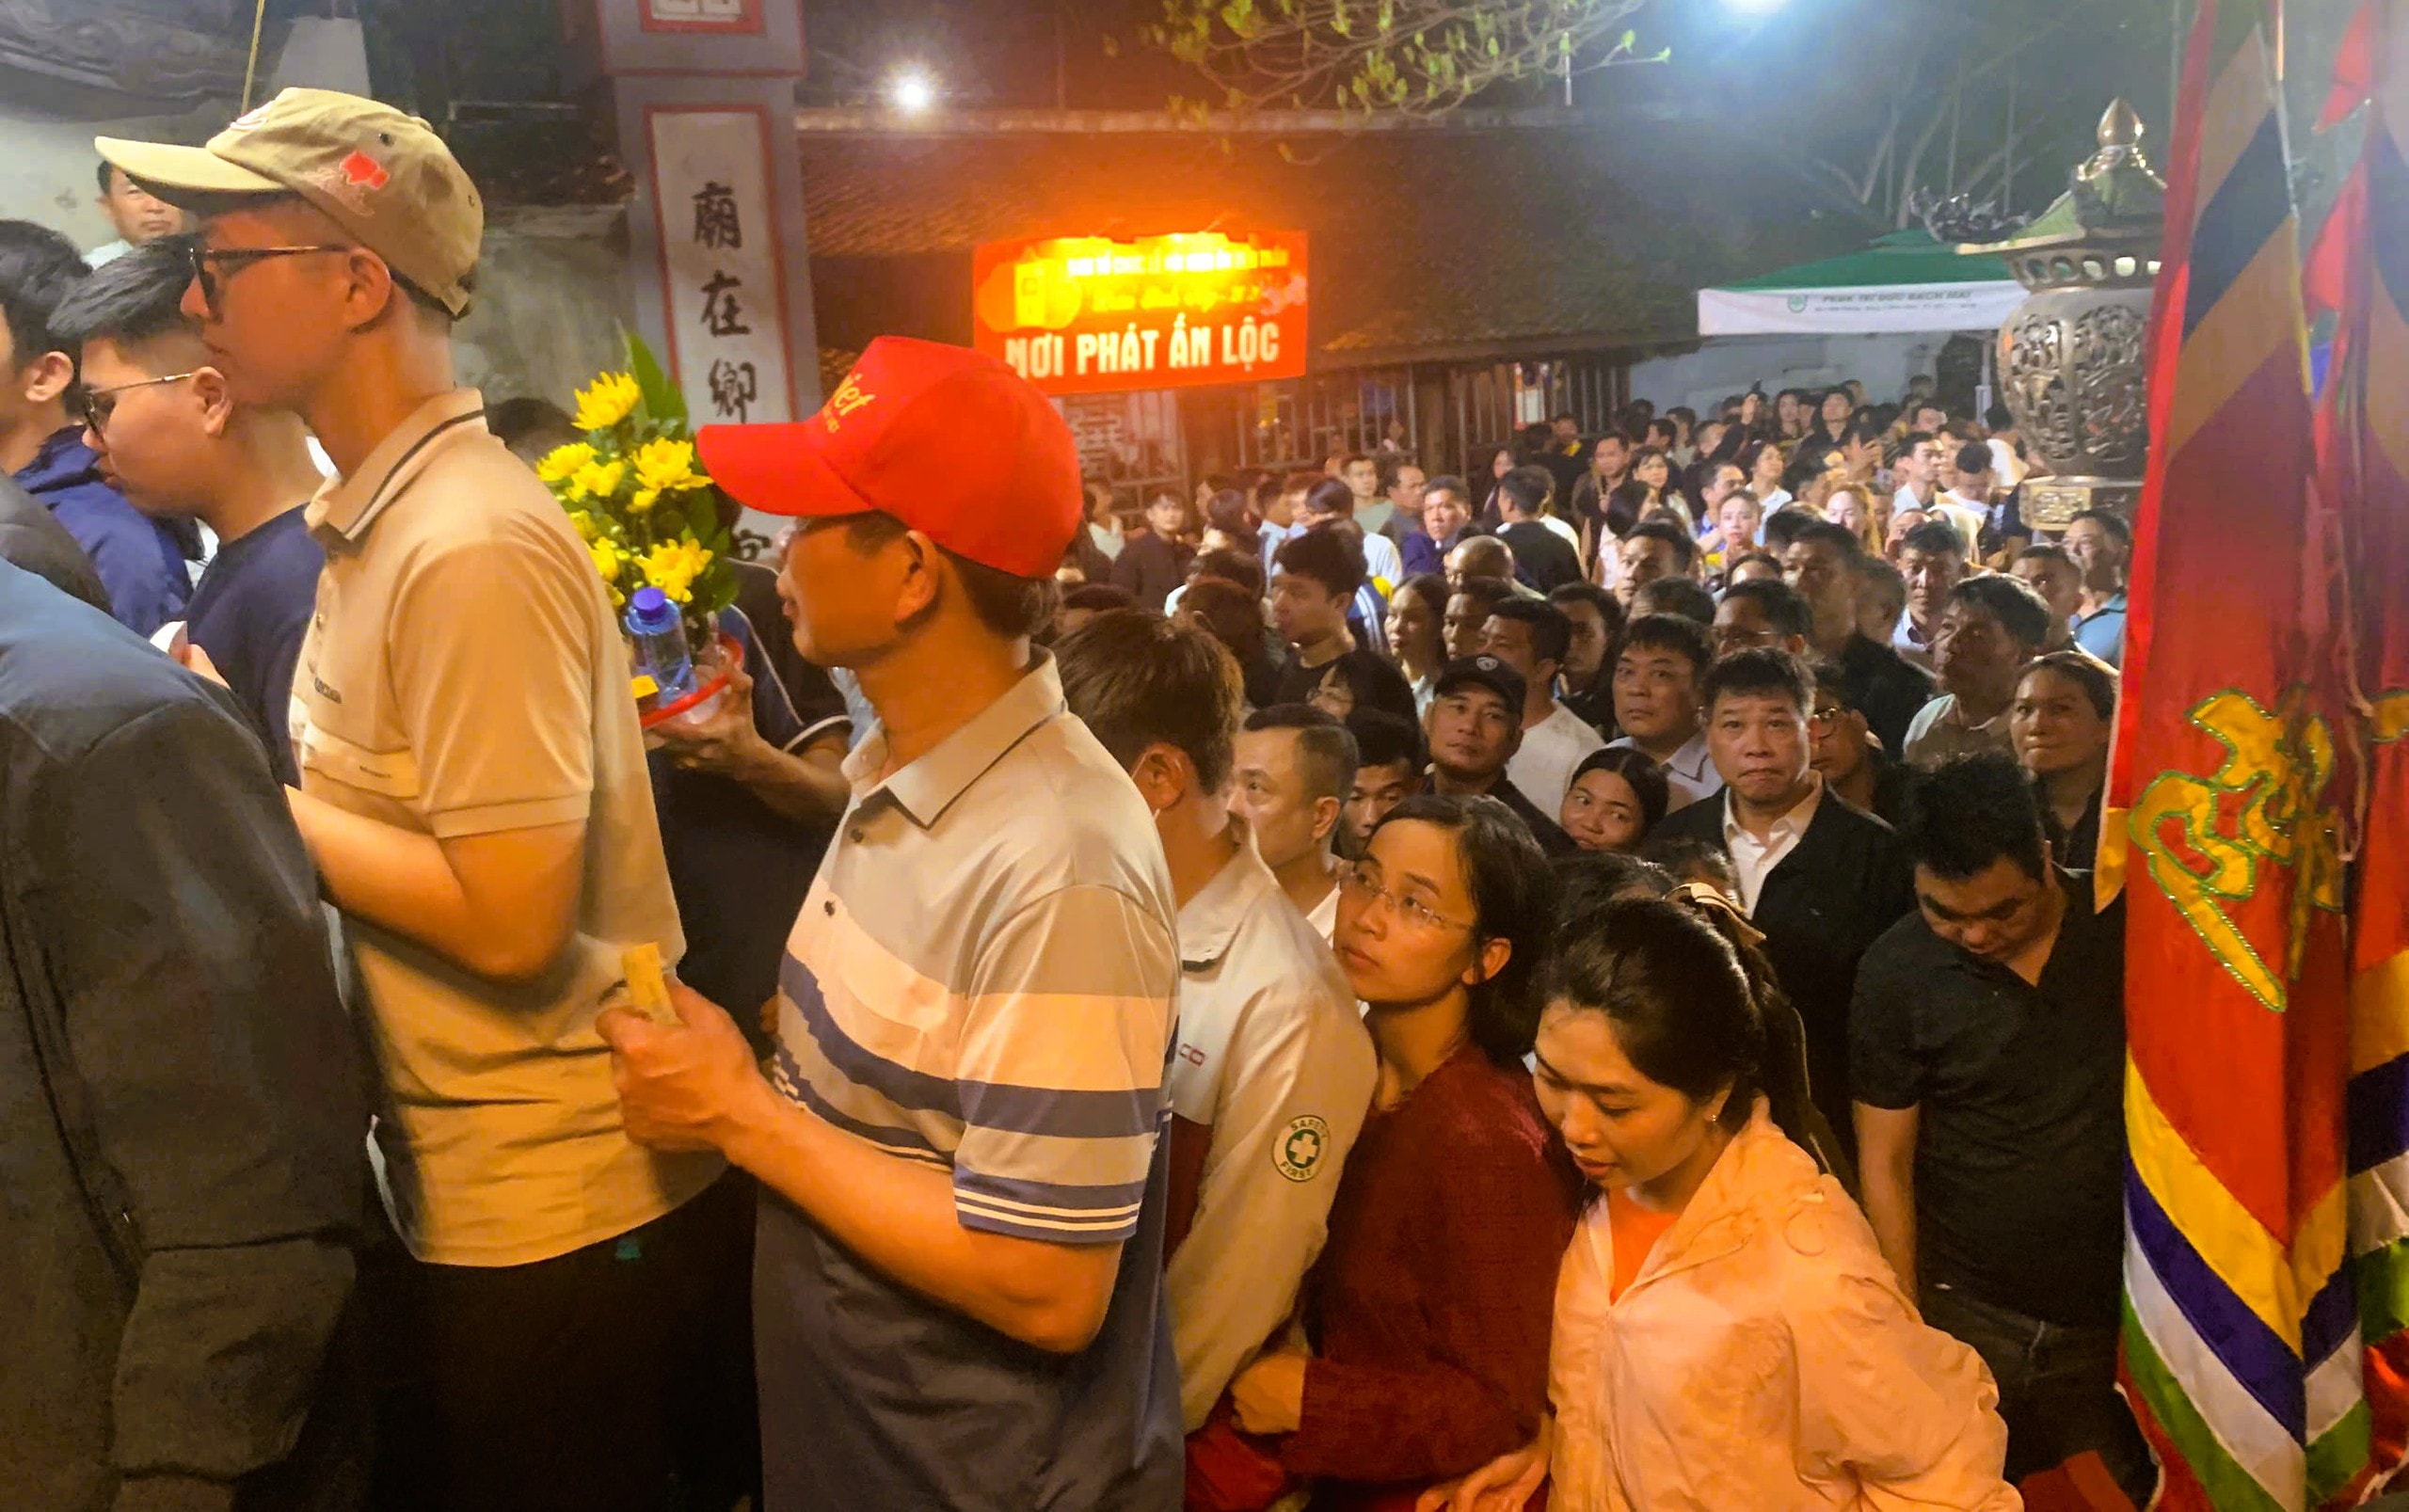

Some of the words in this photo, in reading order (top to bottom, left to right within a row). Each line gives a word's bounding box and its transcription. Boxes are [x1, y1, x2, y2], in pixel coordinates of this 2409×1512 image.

[1006, 333, 1064, 379] NƠI
[1077, 322, 1160, 375] PHÁT
[1169, 311, 1211, 369] ẤN
[1222, 315, 1280, 373] LỘC
[1290, 1119, 1328, 1139] SAFETY
[1280, 1160, 1313, 1179] FIRST
